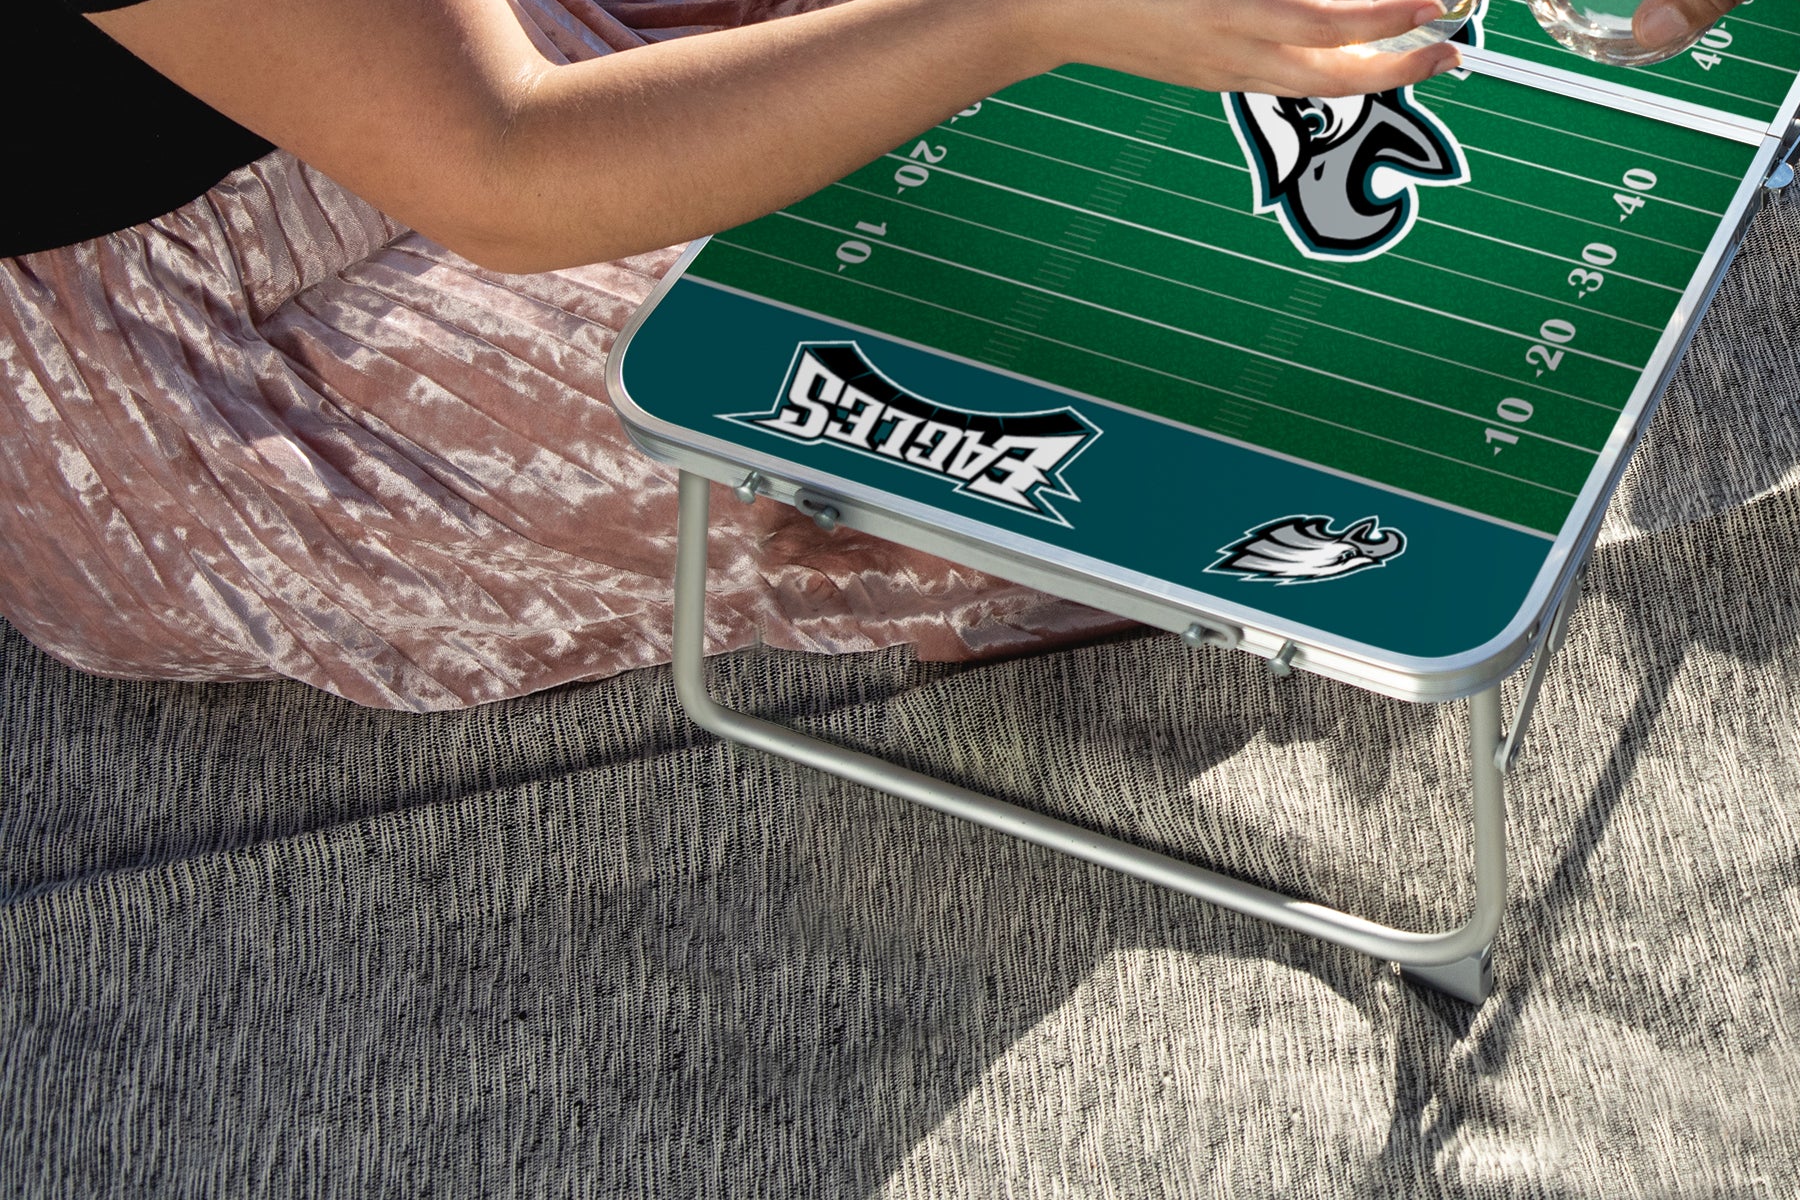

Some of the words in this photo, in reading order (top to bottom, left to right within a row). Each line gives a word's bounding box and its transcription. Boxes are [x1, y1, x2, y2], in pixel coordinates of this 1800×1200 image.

[1690, 28, 1733, 71] 40
[894, 139, 947, 188] 20
[1613, 167, 1658, 216] 40
[835, 219, 888, 265] 10
[1567, 242, 1617, 293] 30
[1525, 318, 1576, 373] 20
[757, 348, 1089, 512] EAGLES
[1484, 397, 1534, 446] 10
